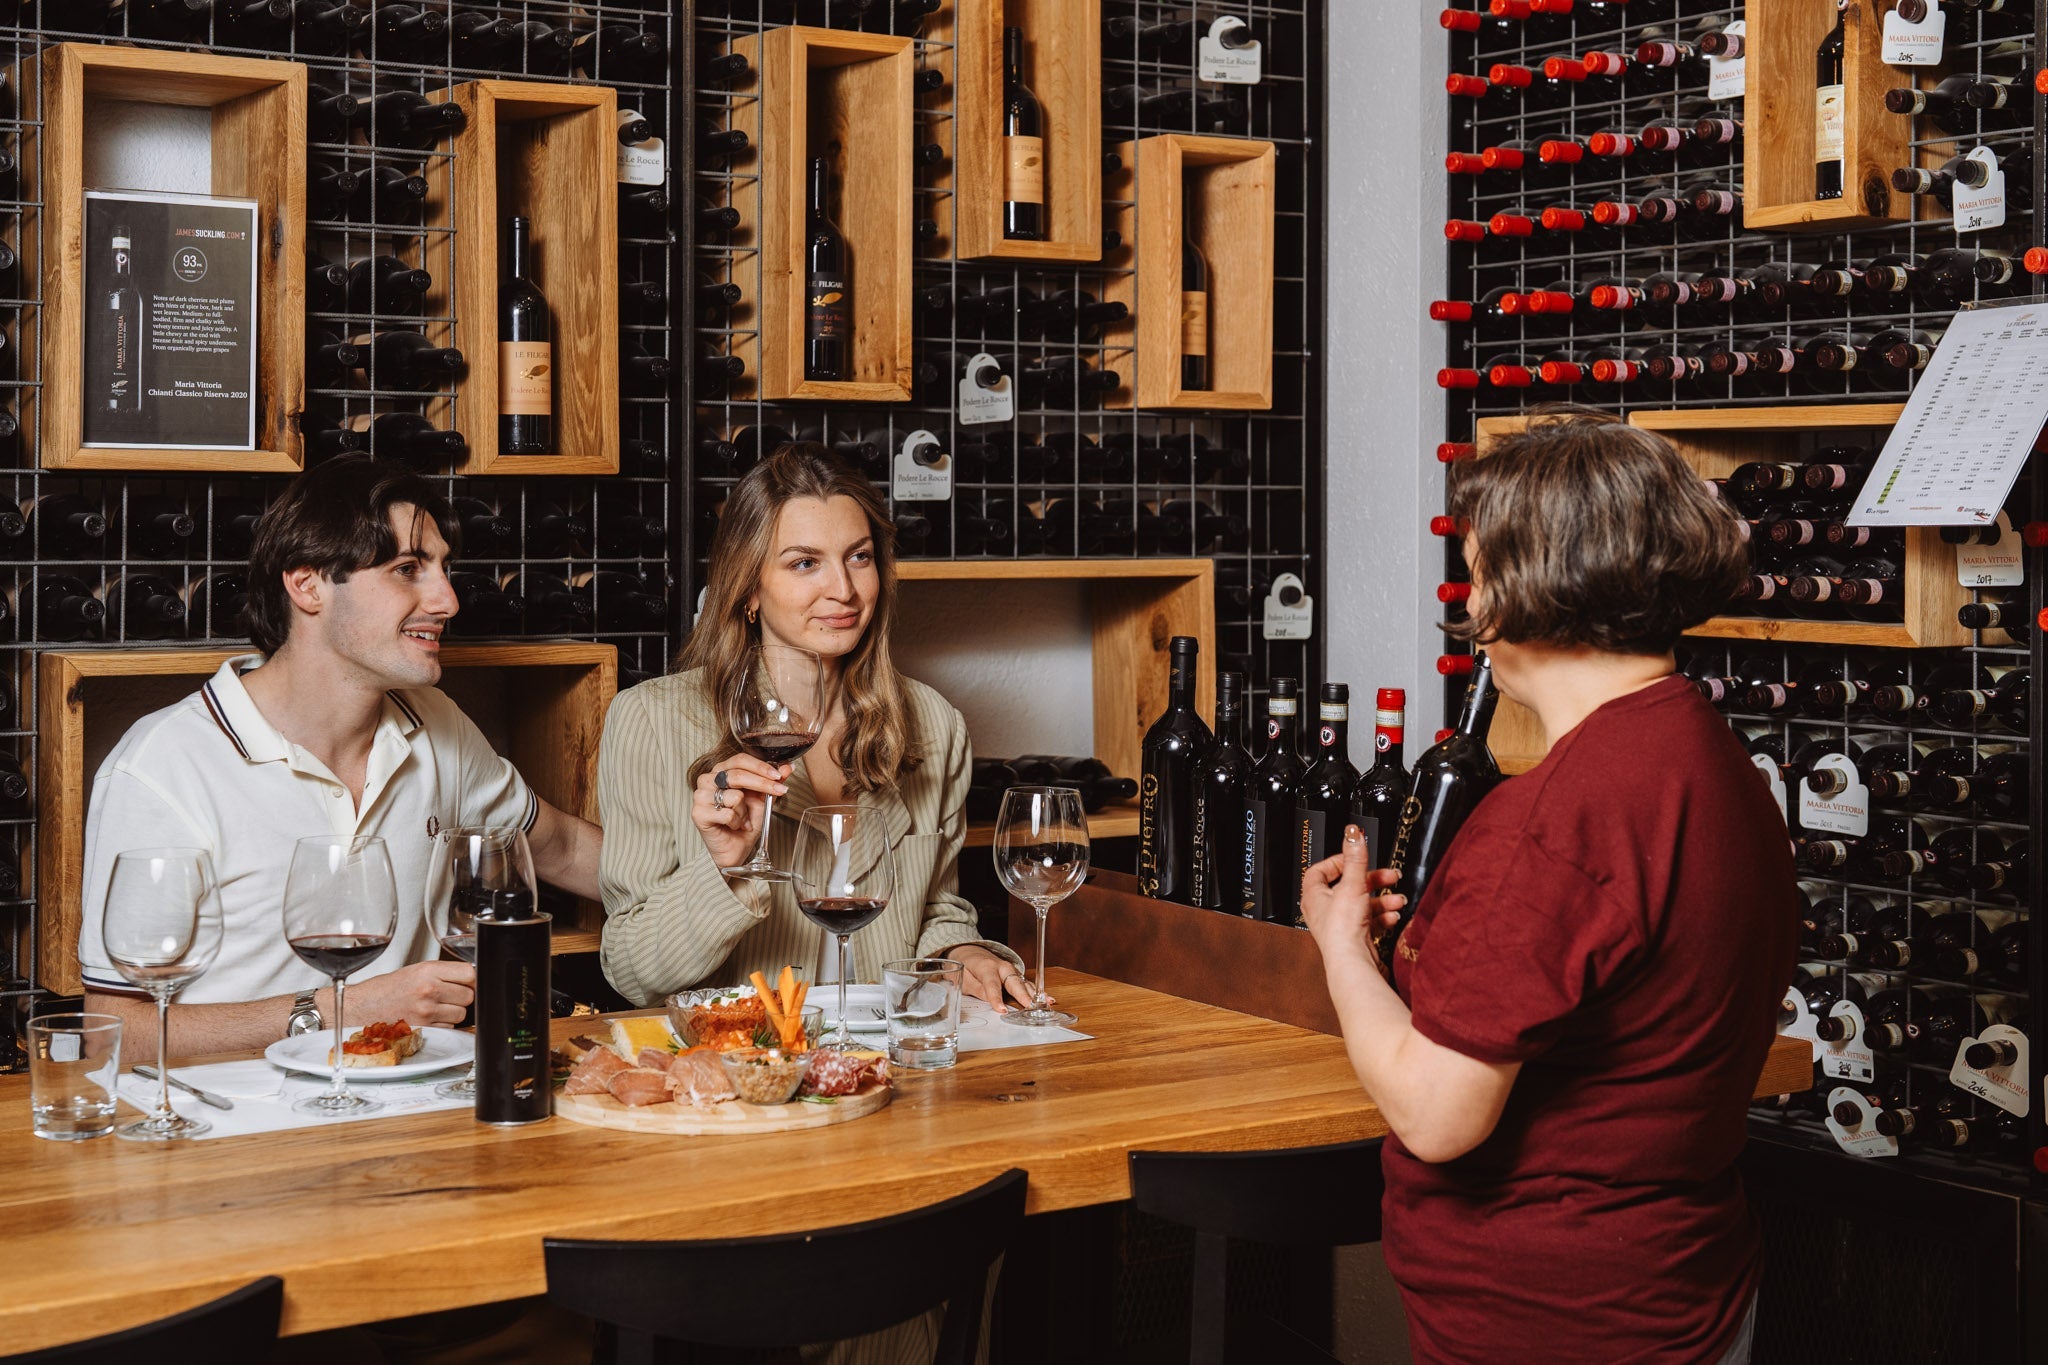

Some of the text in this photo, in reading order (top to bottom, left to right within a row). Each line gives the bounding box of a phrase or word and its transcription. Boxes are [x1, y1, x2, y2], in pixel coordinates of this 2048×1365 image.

[1888, 34, 1940, 43] MARIA VITTORIA
[1898, 52, 1914, 63] 2015
[625, 154, 661, 165] Le Rocce
[1958, 201, 1978, 210] MARIA
[1979, 196, 2003, 207] VITTORIA
[182, 254, 197, 267] 93
[117, 315, 125, 347] VITTORIA
[196, 381, 222, 389] Vittoria
[148, 388, 248, 399] Chianti Classico Riserva 2020
[1963, 555, 2019, 565] MARIA VITTORIA
[1976, 574, 1992, 585] 2017
[1807, 800, 1831, 810] MARIA
[1833, 803, 1865, 815] VITTORIA
[1244, 809, 1254, 884] LORENZO
[1301, 819, 1309, 864] VITTORIA
[1192, 798, 1205, 907] dere Le Rocce
[1826, 1049, 1846, 1058] MARIA
[1847, 1051, 1871, 1062] VITTORIA
[1968, 1080, 1988, 1097] 2016
[1992, 1071, 2029, 1098] VITTORIA
[1841, 1132, 1862, 1143] MARIA
